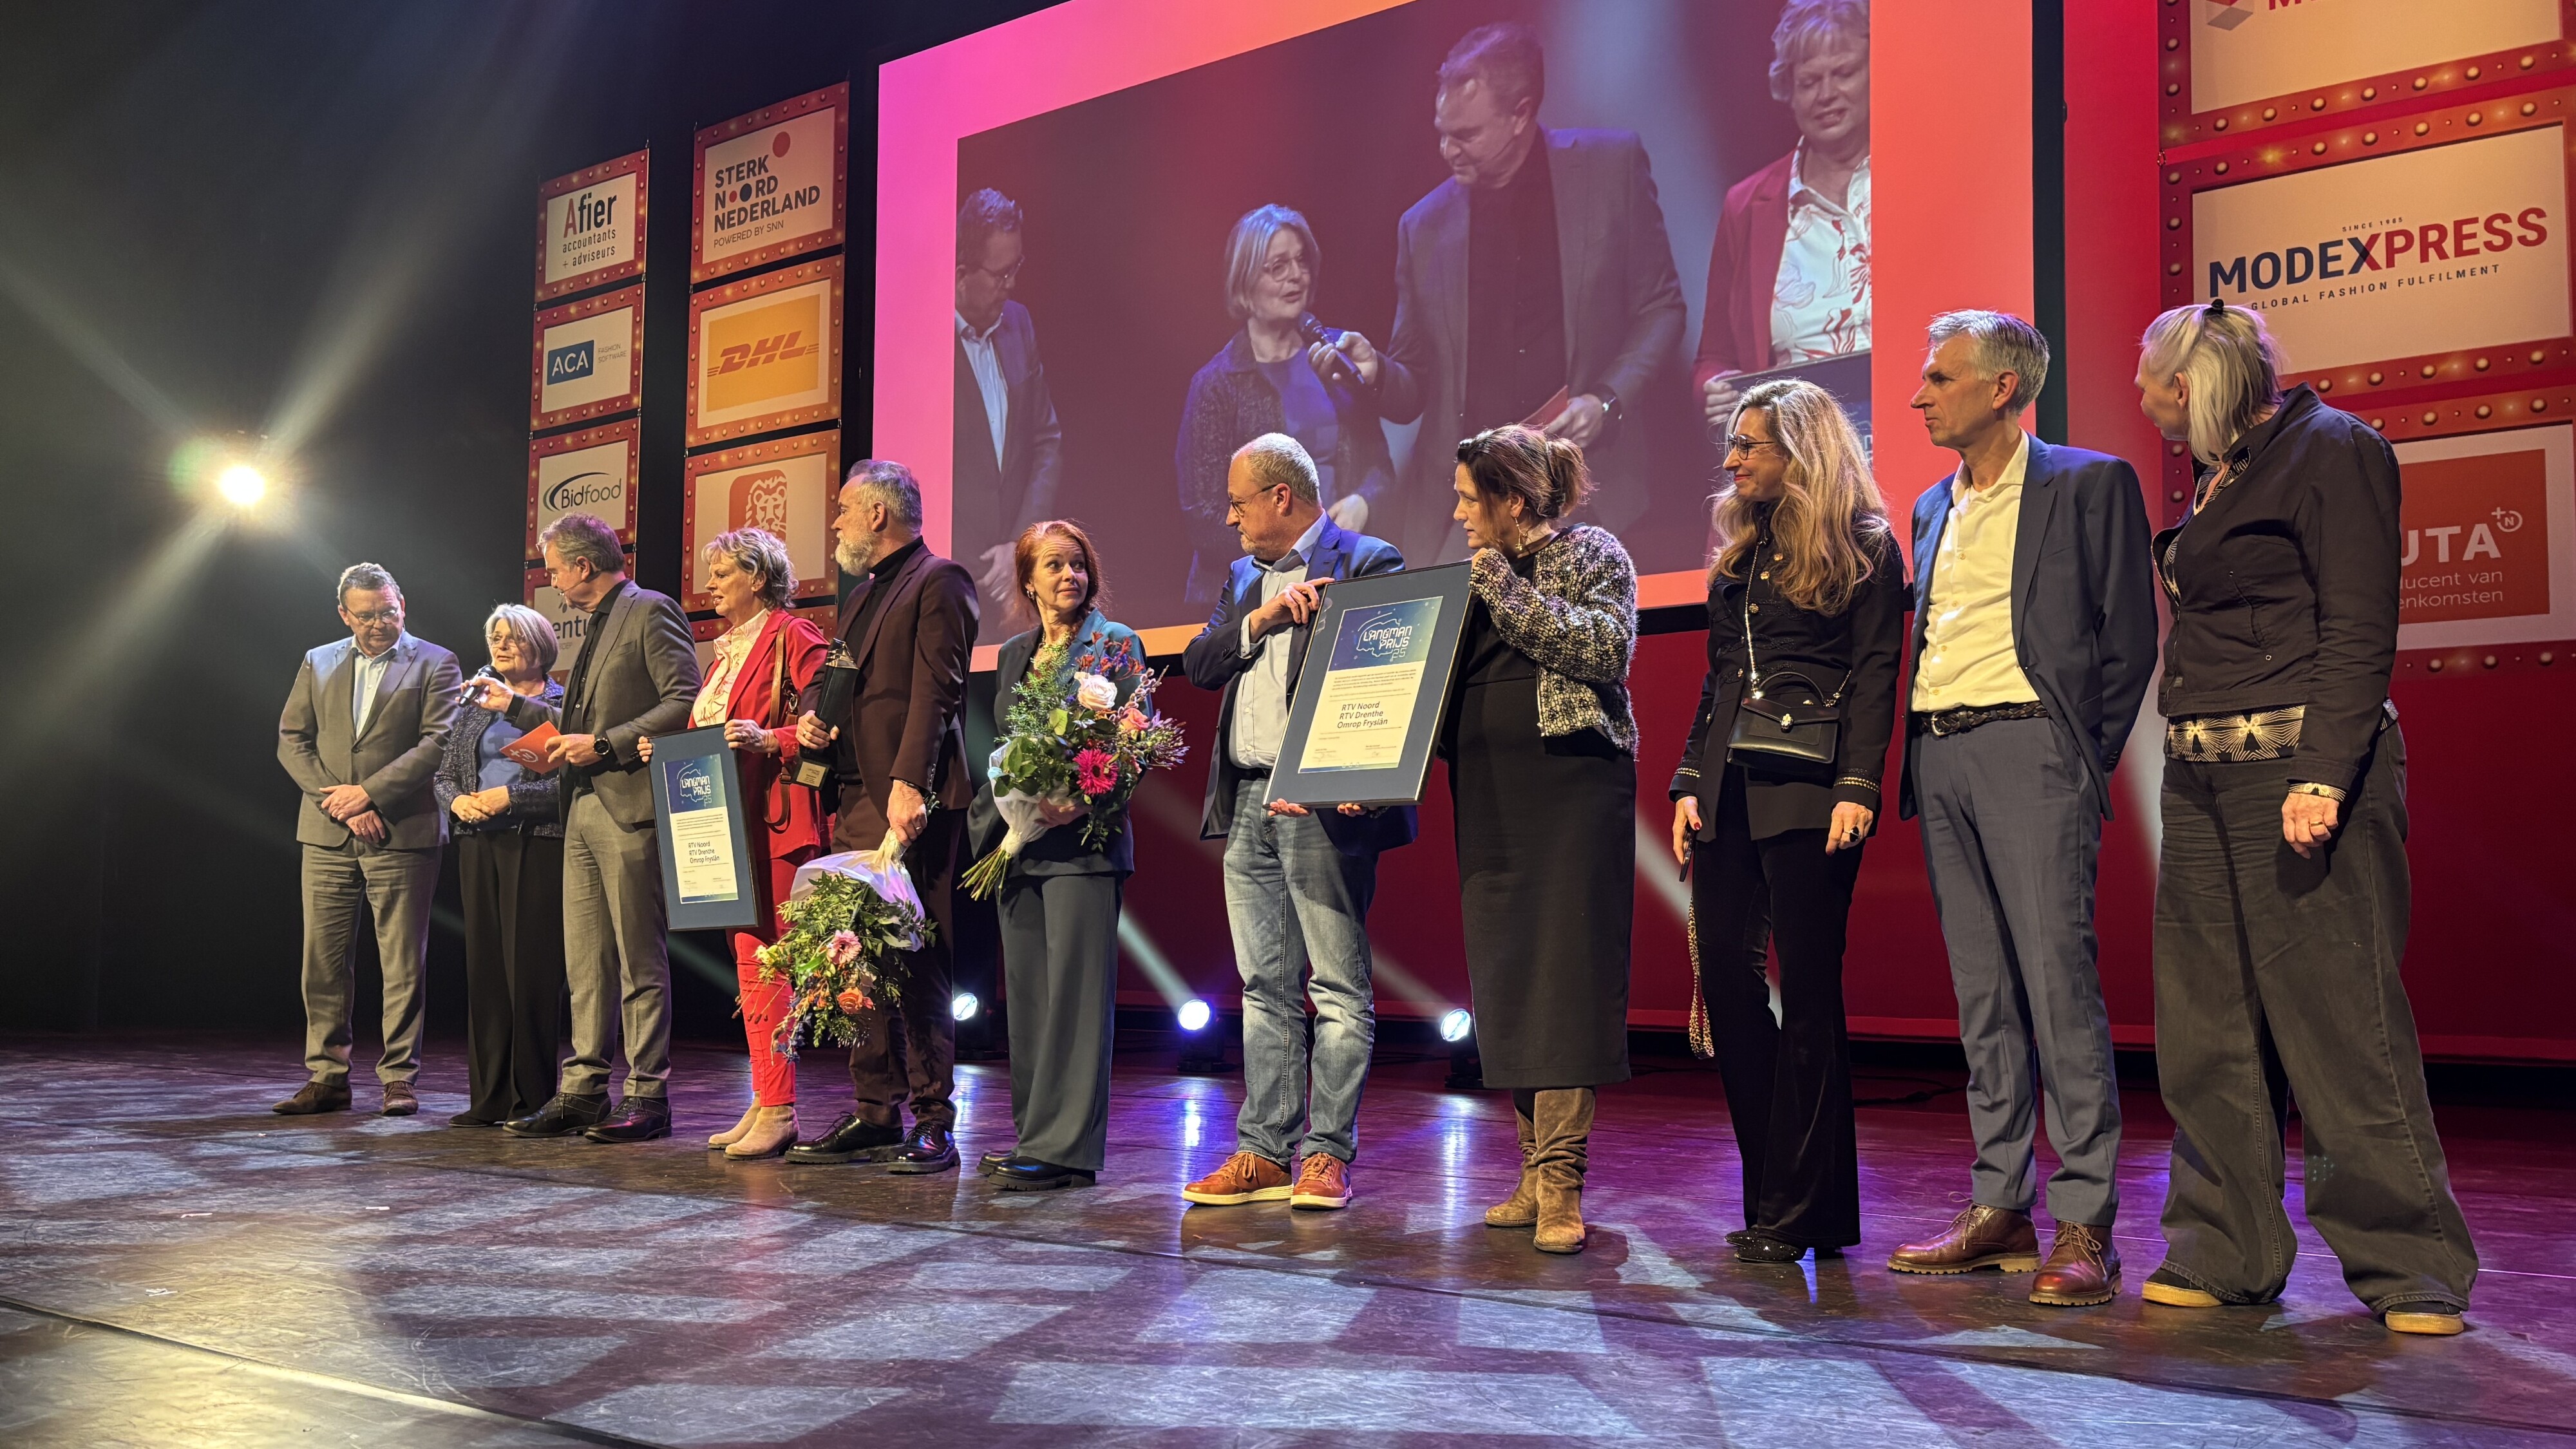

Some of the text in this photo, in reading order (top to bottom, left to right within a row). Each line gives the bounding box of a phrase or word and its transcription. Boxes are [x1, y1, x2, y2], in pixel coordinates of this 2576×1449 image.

[715, 155, 769, 189] STERK
[564, 192, 617, 238] Afier
[714, 185, 820, 233] NEDERLAND
[714, 220, 784, 248] POWERED BY SNN
[2342, 222, 2372, 232] SINCE
[563, 229, 616, 253] accountants
[573, 245, 615, 266] adviseurs
[2209, 207, 2548, 298] MODEXPRESS
[2251, 264, 2501, 311] GLOBAL FASHION FULFILMENT
[598, 343, 621, 354] FASHION
[598, 350, 627, 363] SOFTWARE
[719, 330, 802, 375] DHL
[552, 350, 589, 377] ACA
[561, 477, 621, 509] Bidfood
[2400, 571, 2503, 590] ucent van
[1363, 626, 1412, 641] LANGMAN
[1379, 636, 1410, 650] PRIJS
[1391, 648, 1406, 659] 25
[1355, 710, 1384, 719] Drenthe
[1358, 701, 1380, 710] Noord
[681, 775, 710, 788] LANGMAN
[693, 784, 711, 796] PRIJS
